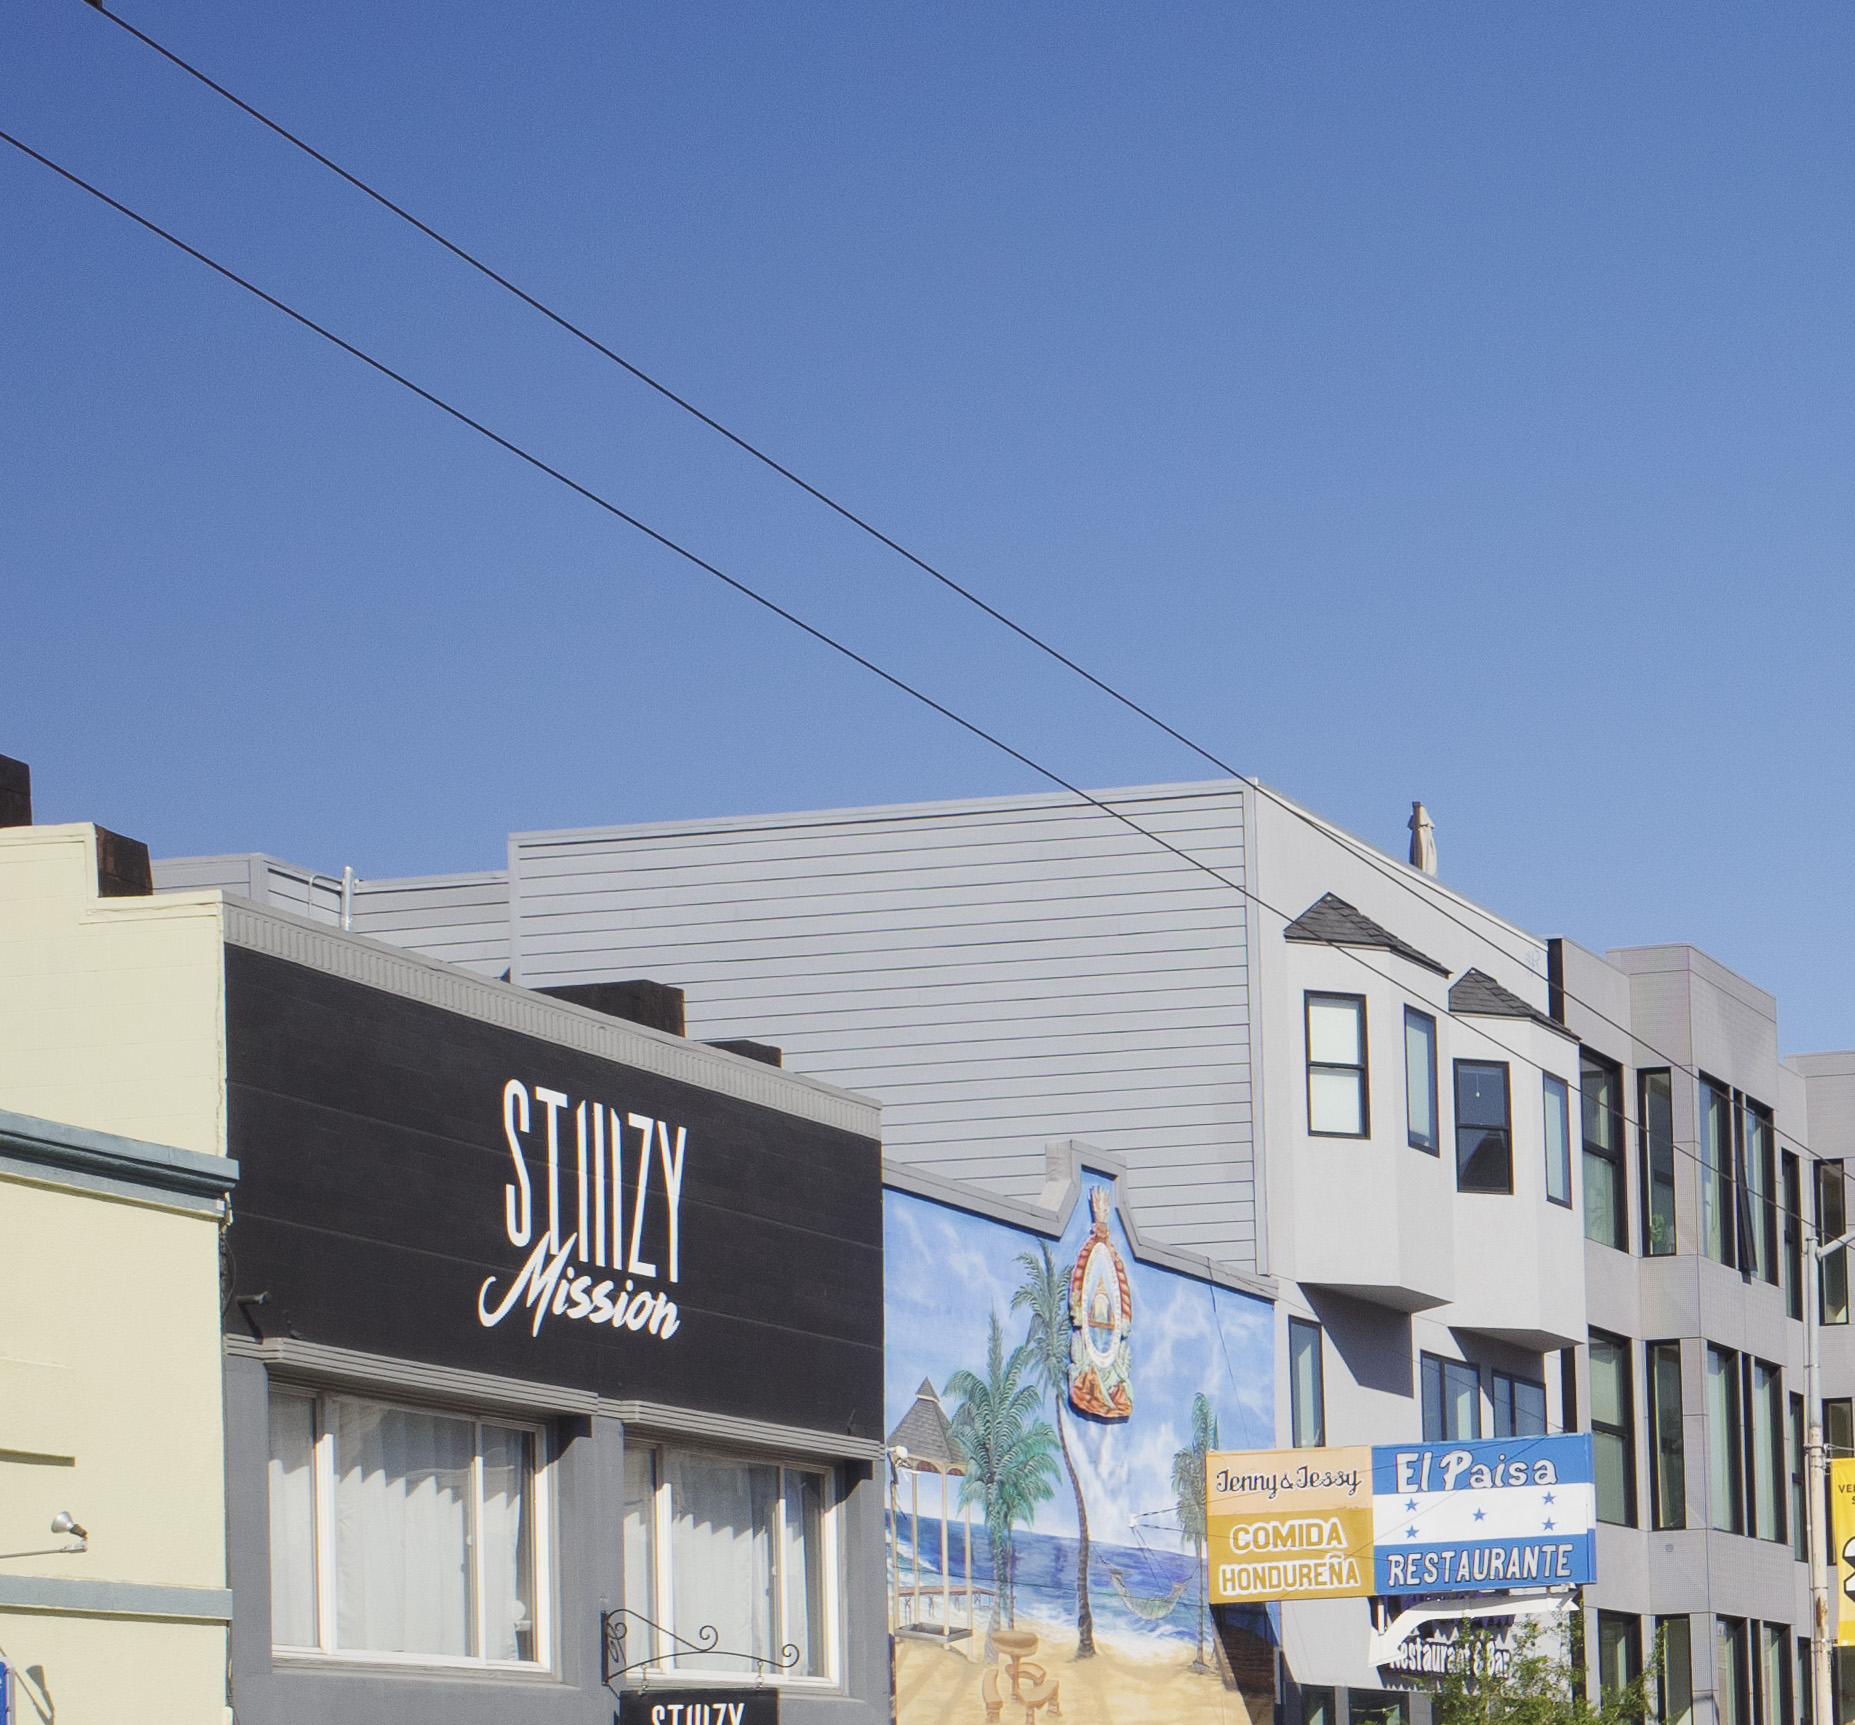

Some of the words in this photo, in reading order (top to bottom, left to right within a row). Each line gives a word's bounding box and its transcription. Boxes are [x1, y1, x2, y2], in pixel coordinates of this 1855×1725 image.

[478, 1230, 681, 1341] Mission
[1395, 1451, 1431, 1494] El
[1440, 1449, 1559, 1492] Paisa
[1229, 1516, 1348, 1555] COMIDA
[1219, 1552, 1362, 1596] HONDUREÑA
[1387, 1543, 1574, 1588] RESTAURANTE
